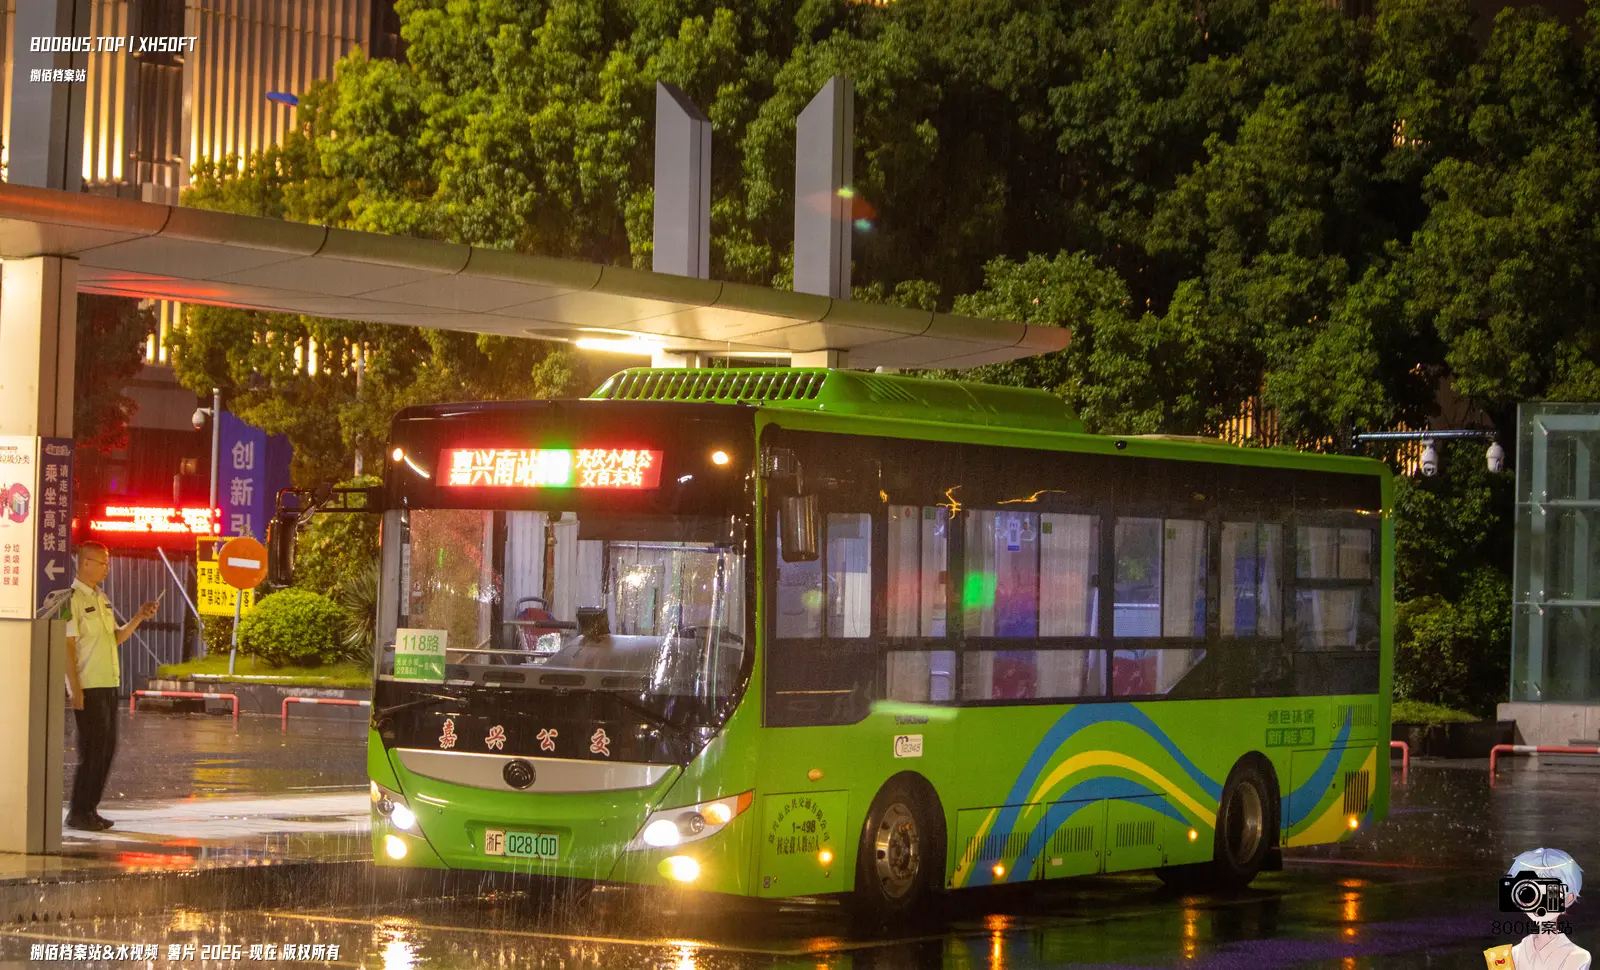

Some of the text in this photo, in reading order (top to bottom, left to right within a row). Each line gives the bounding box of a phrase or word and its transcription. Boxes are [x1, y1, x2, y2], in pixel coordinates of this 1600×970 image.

[43, 464, 57, 552] 乘坐高铁
[58, 464, 68, 553] 请走地下通道
[402, 633, 439, 652] 118路
[440, 718, 610, 757] 嘉兴公交
[792, 820, 816, 833] 1-498
[508, 835, 557, 856] 02810D
